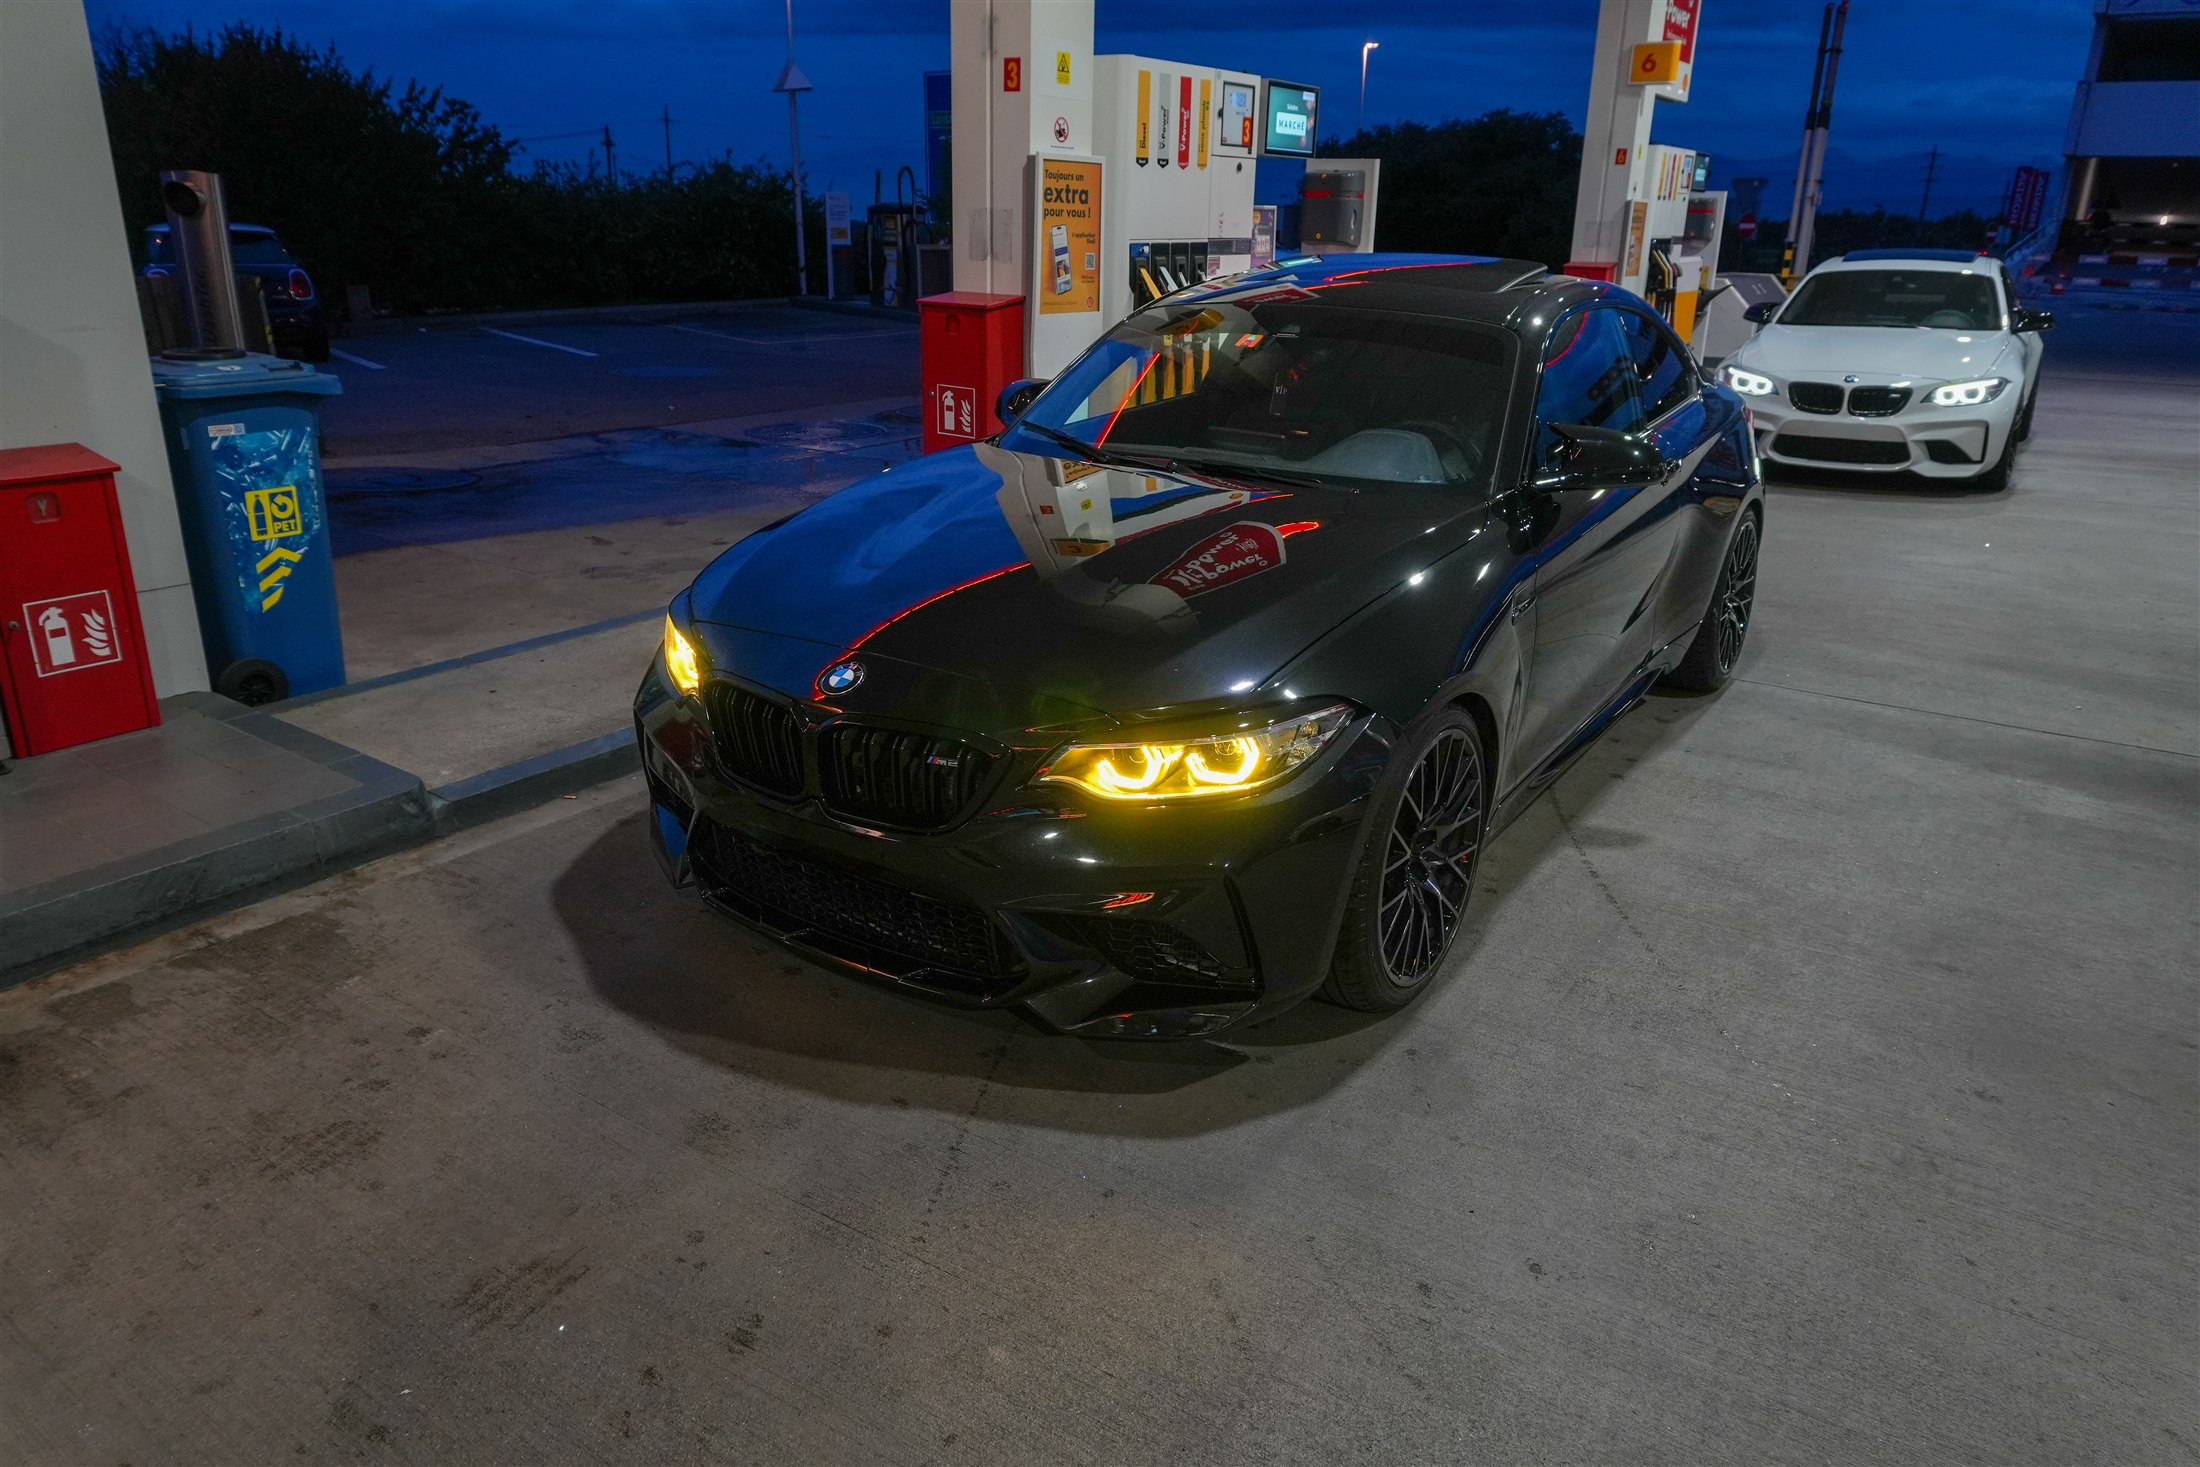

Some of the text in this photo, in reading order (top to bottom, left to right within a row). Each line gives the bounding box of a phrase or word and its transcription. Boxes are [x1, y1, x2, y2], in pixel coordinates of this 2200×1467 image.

[1641, 52, 1657, 73] 6
[1007, 61, 1018, 89] 3
[1243, 119, 1250, 142] 3
[1617, 151, 1625, 164] 6
[1045, 169, 1074, 182] Toujours
[1044, 184, 1089, 205] extra
[1044, 208, 1064, 220] pour
[1066, 209, 1086, 218] vous
[273, 518, 298, 533] PET
